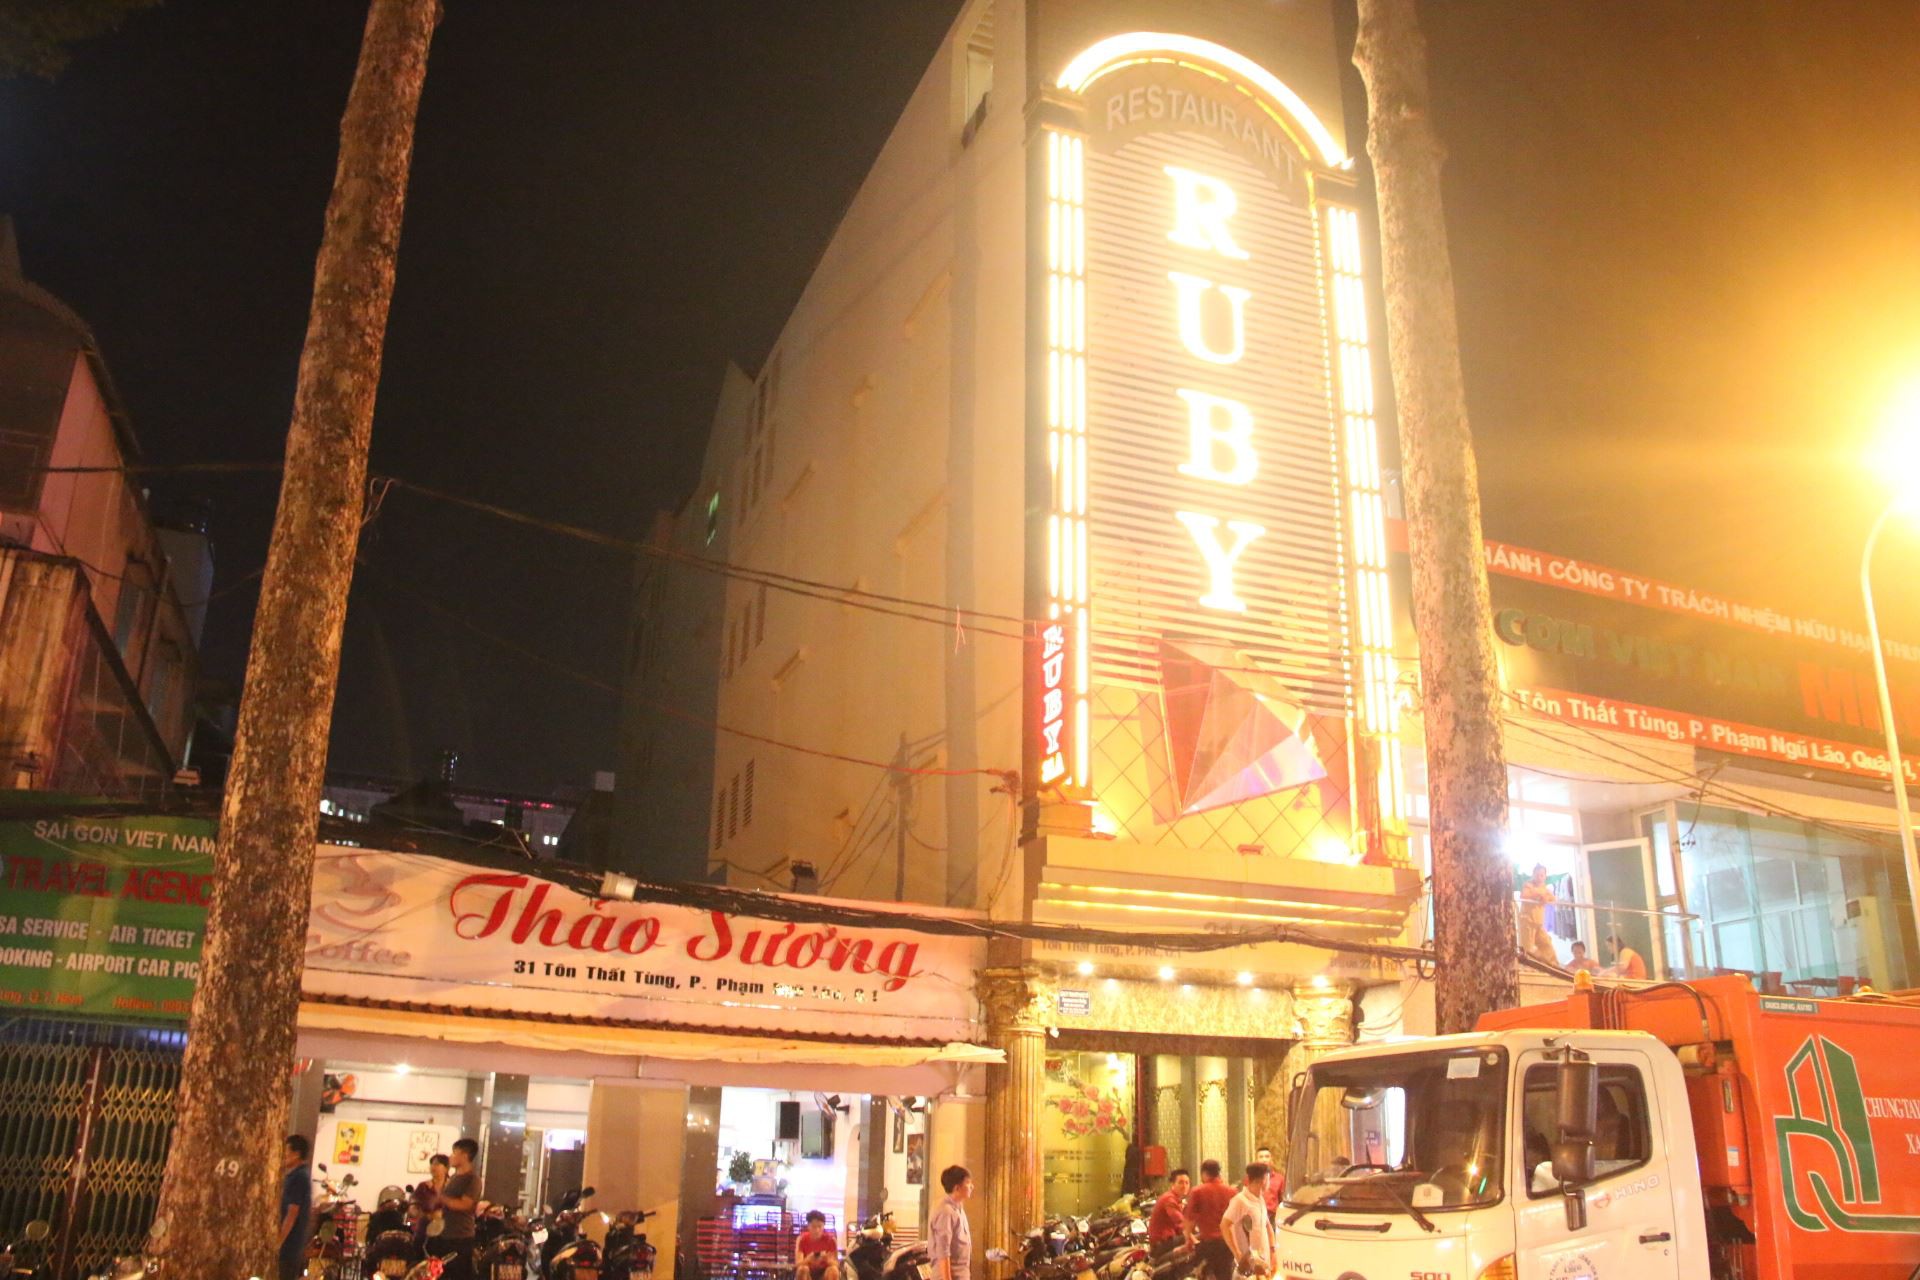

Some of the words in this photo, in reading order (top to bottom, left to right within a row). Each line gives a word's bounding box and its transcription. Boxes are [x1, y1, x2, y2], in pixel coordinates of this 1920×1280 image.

[1106, 84, 1298, 182] RESTAURANT
[1163, 163, 1267, 613] RUBY
[1548, 560, 1615, 592] CÔNG
[1621, 577, 1651, 600] TY
[1656, 585, 1729, 620] TRÁCH
[1732, 604, 1793, 634] NHIỆM
[1516, 689, 1561, 716] Tôn
[1567, 698, 1618, 725] Thất
[1624, 708, 1685, 740] Tùng,
[1689, 719, 1707, 740] P.
[1711, 724, 1767, 753] Phạm
[1770, 734, 1809, 761] Ngũ
[34, 820, 68, 840] SAI
[73, 826, 119, 844] GON
[124, 828, 168, 849] VIET
[172, 834, 216, 854] NAM
[7, 855, 113, 897] TRAVEL
[450, 873, 667, 955] Thảo
[22, 918, 89, 940] SERVICE
[109, 924, 138, 944] AIR
[143, 927, 196, 949] TICKET
[66, 952, 135, 974] AIRPORT
[138, 959, 170, 977] CAR
[514, 960, 536, 975] 31
[543, 962, 577, 979] Tôn
[586, 965, 626, 983] Thất
[634, 969, 682, 990] Tùng,
[689, 974, 708, 990] P.
[716, 979, 765, 997] Phạm
[215, 1158, 240, 1178] 49
[1615, 1175, 1660, 1200] HINO
[1282, 1259, 1313, 1274] HINO
